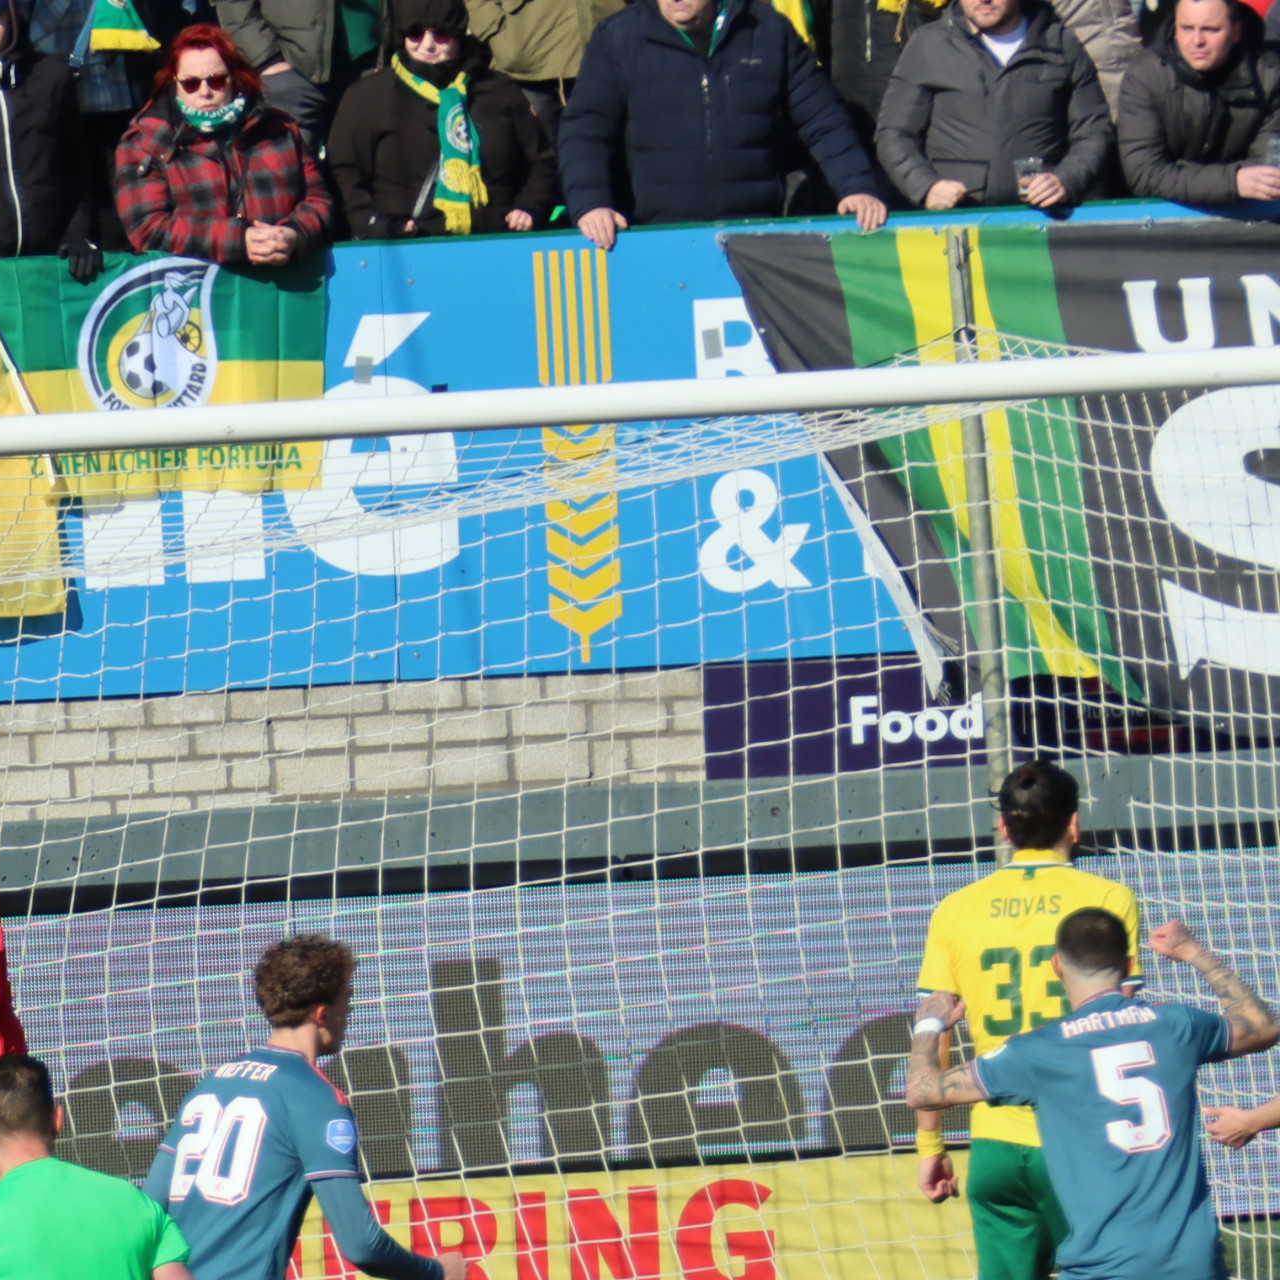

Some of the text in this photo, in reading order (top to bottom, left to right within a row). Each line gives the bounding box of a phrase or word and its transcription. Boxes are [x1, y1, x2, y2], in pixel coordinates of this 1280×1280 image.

[850, 691, 984, 745] Food
[989, 895, 1062, 919] SIOVAS
[980, 947, 1073, 1037] 33
[1060, 1006, 1158, 1039] HARTMAN
[1090, 1040, 1171, 1154] 5
[169, 1093, 268, 1207] 20
